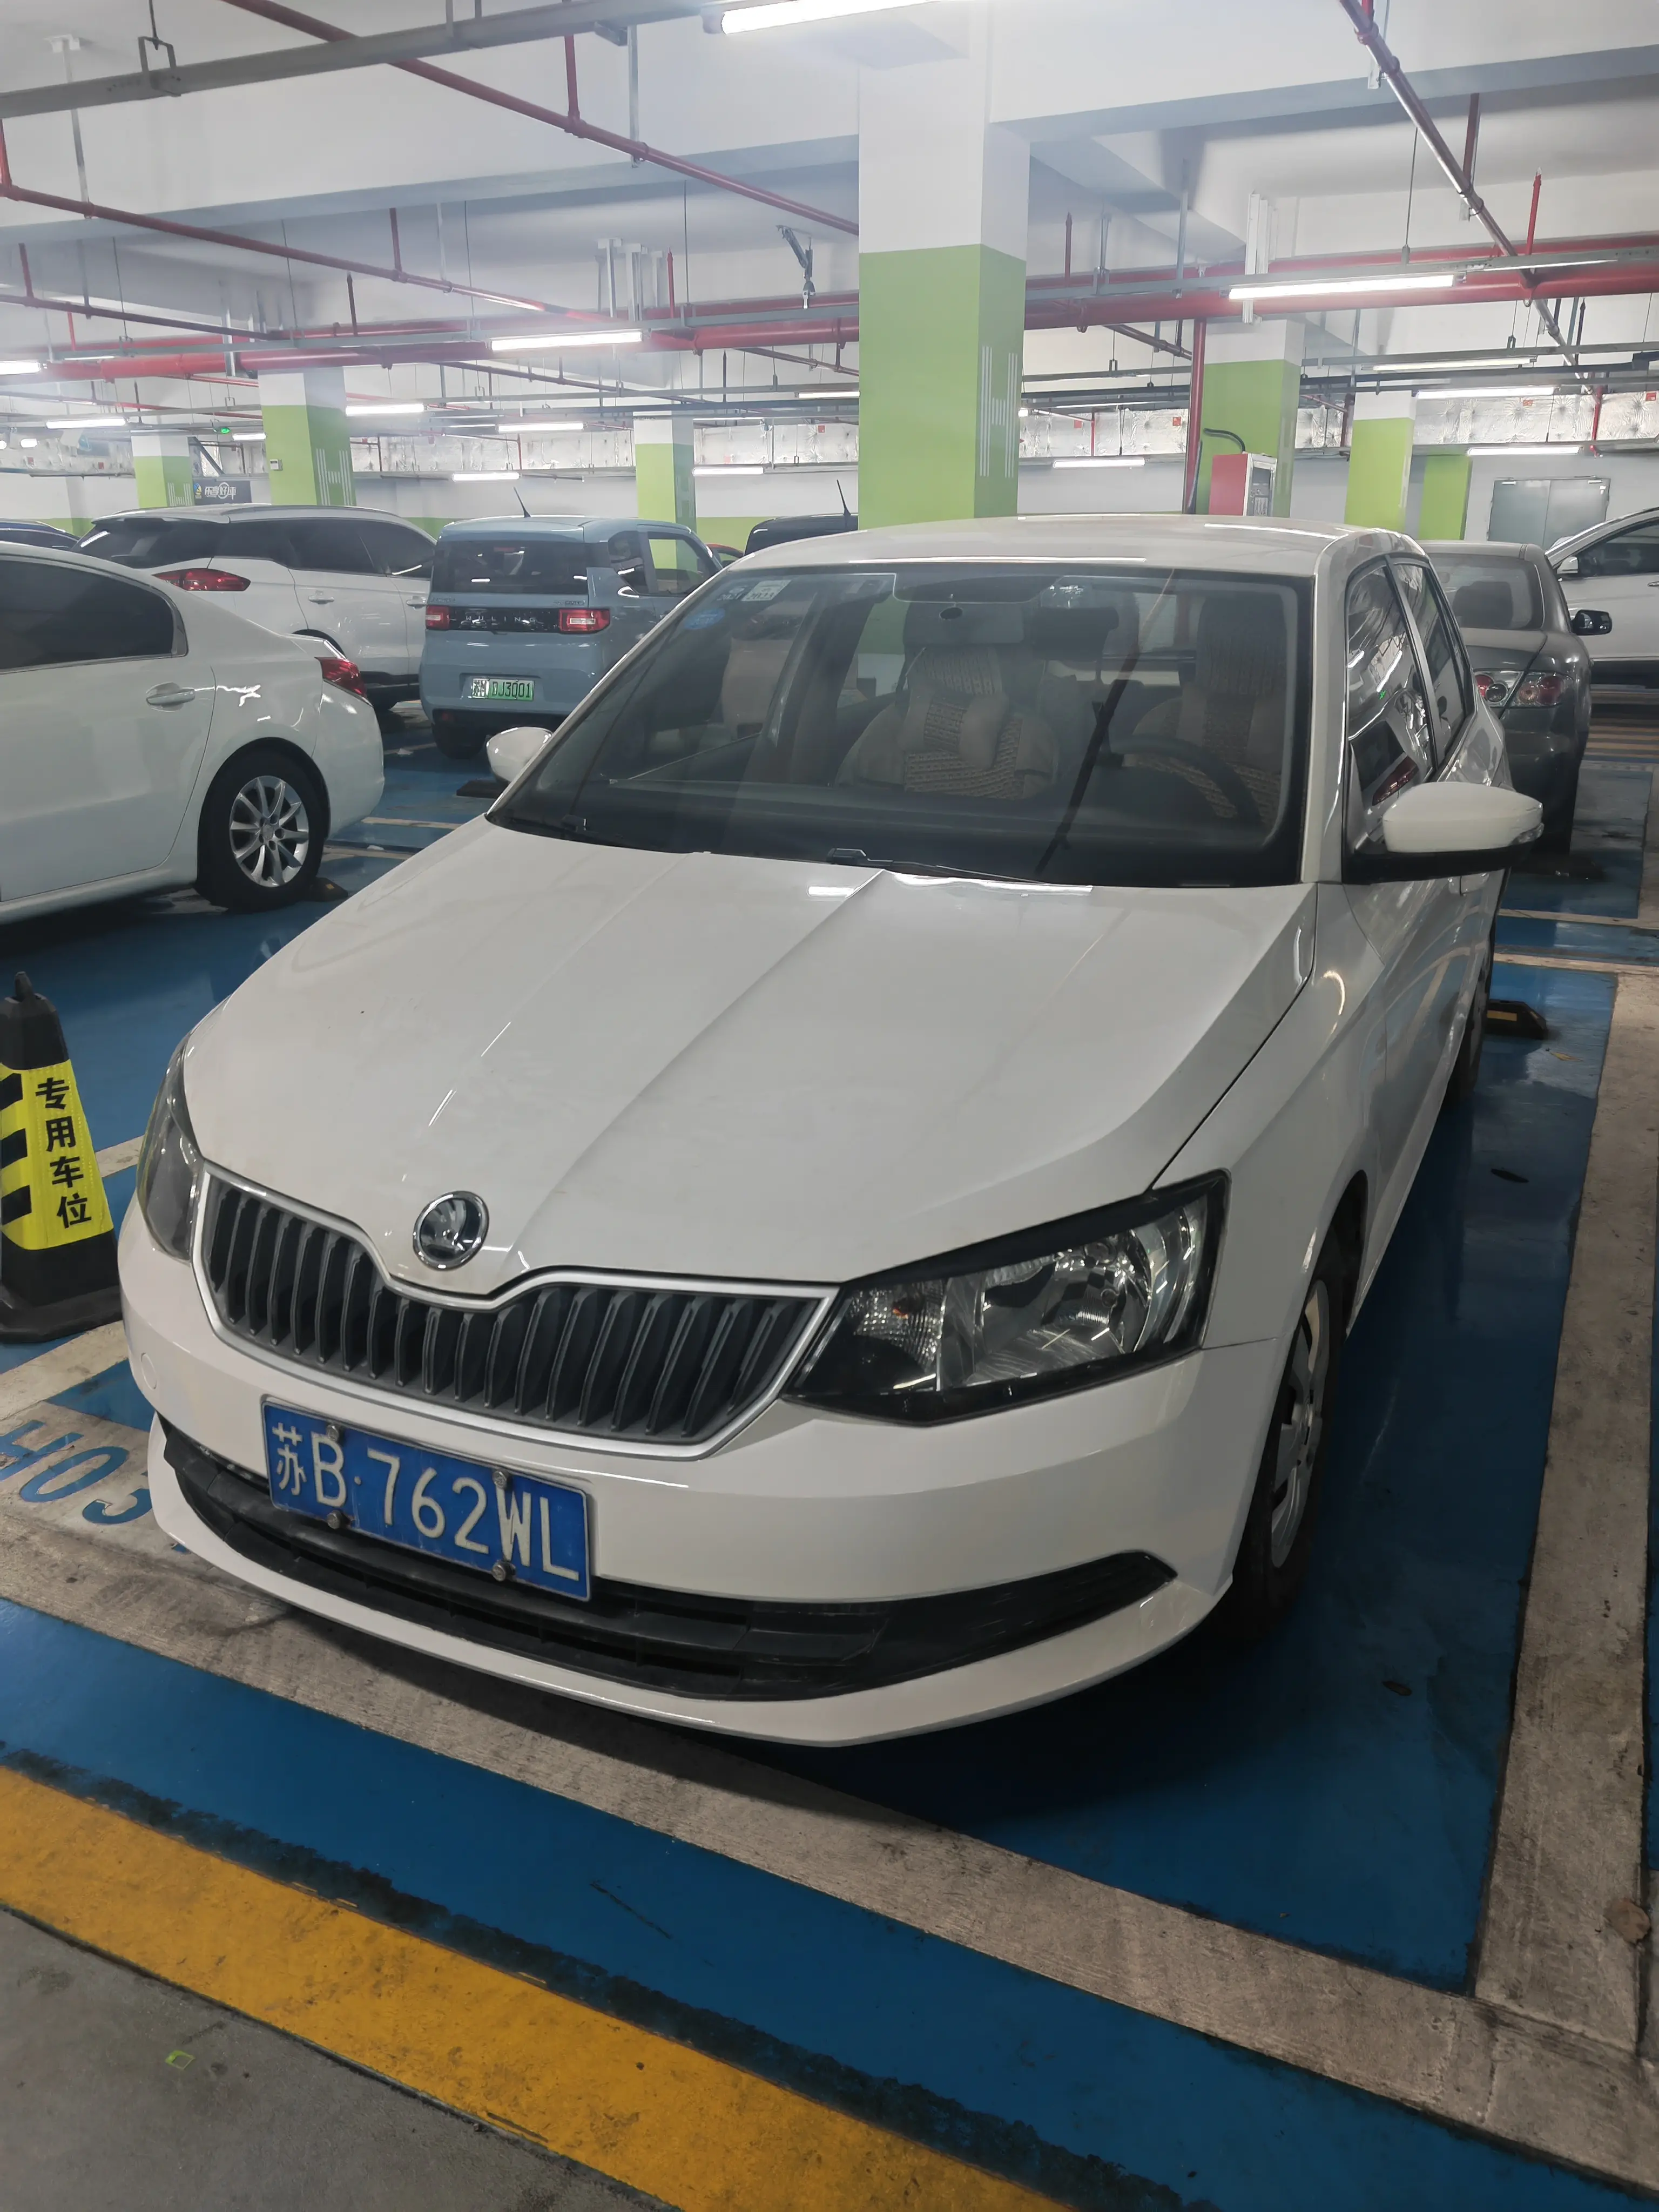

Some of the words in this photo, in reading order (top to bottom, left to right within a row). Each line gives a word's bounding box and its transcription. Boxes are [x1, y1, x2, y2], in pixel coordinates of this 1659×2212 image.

[316, 448, 353, 506] H
[979, 345, 1018, 478] H
[36, 1077, 92, 1229] 专用车位
